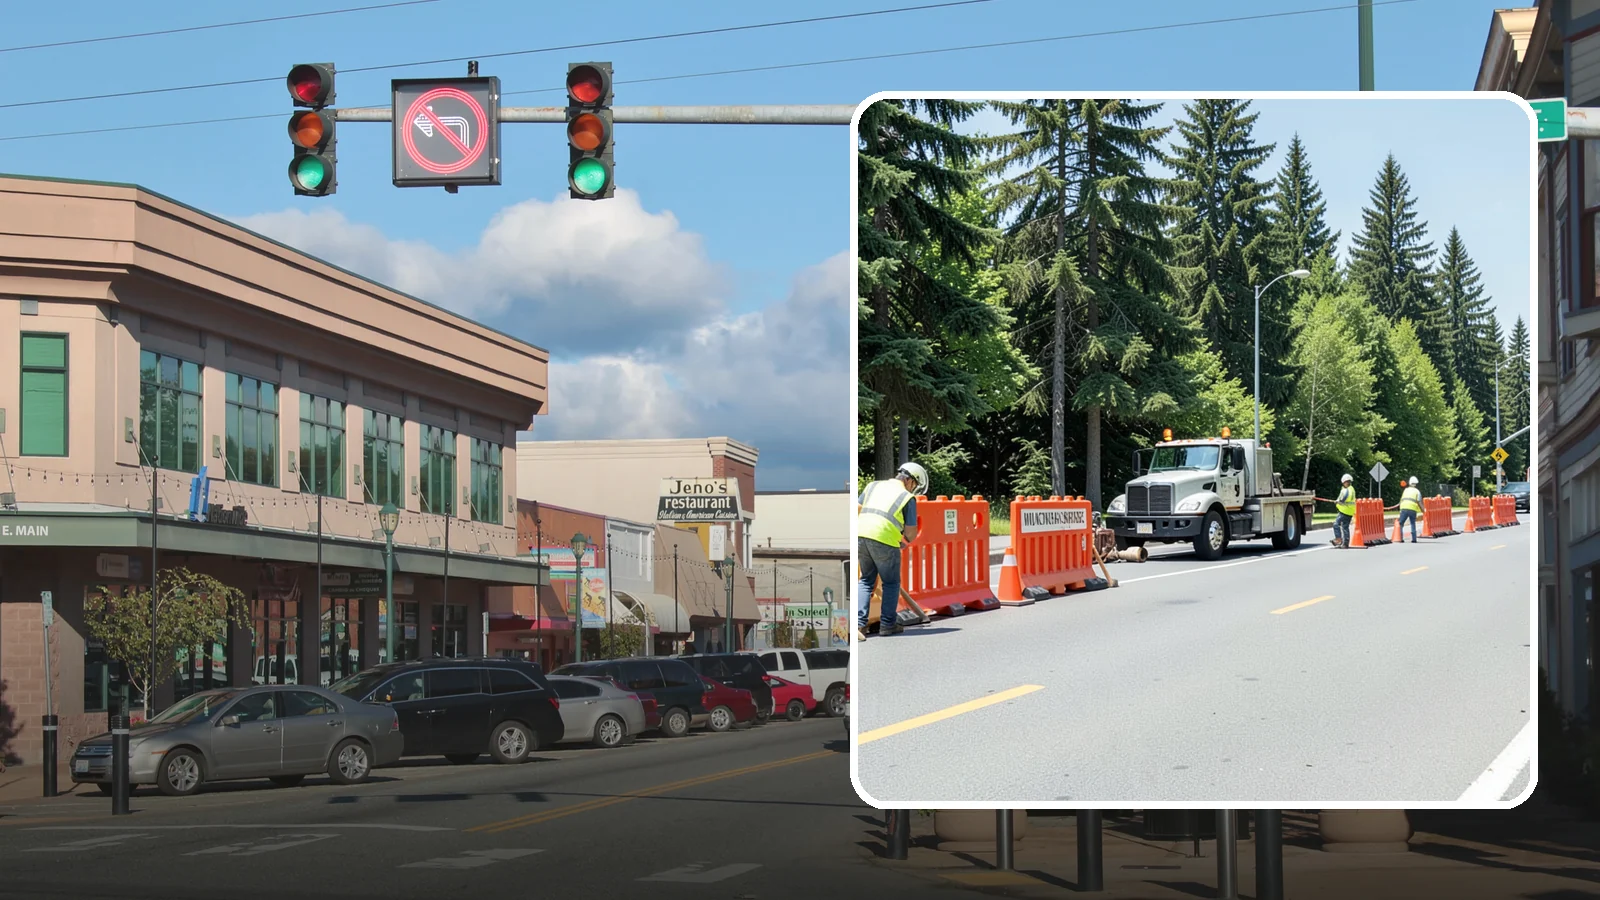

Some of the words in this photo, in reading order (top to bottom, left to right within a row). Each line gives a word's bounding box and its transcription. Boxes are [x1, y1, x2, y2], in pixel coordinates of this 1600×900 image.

[670, 480, 728, 494] Jeno's
[665, 496, 731, 509] restaurant
[658, 509, 681, 520] Italian
[686, 509, 714, 519] American
[715, 509, 737, 519] Cuisine
[2, 525, 13, 536] E.
[16, 525, 49, 536] MAIN
[797, 607, 829, 616] Street
[790, 619, 824, 627] lass
